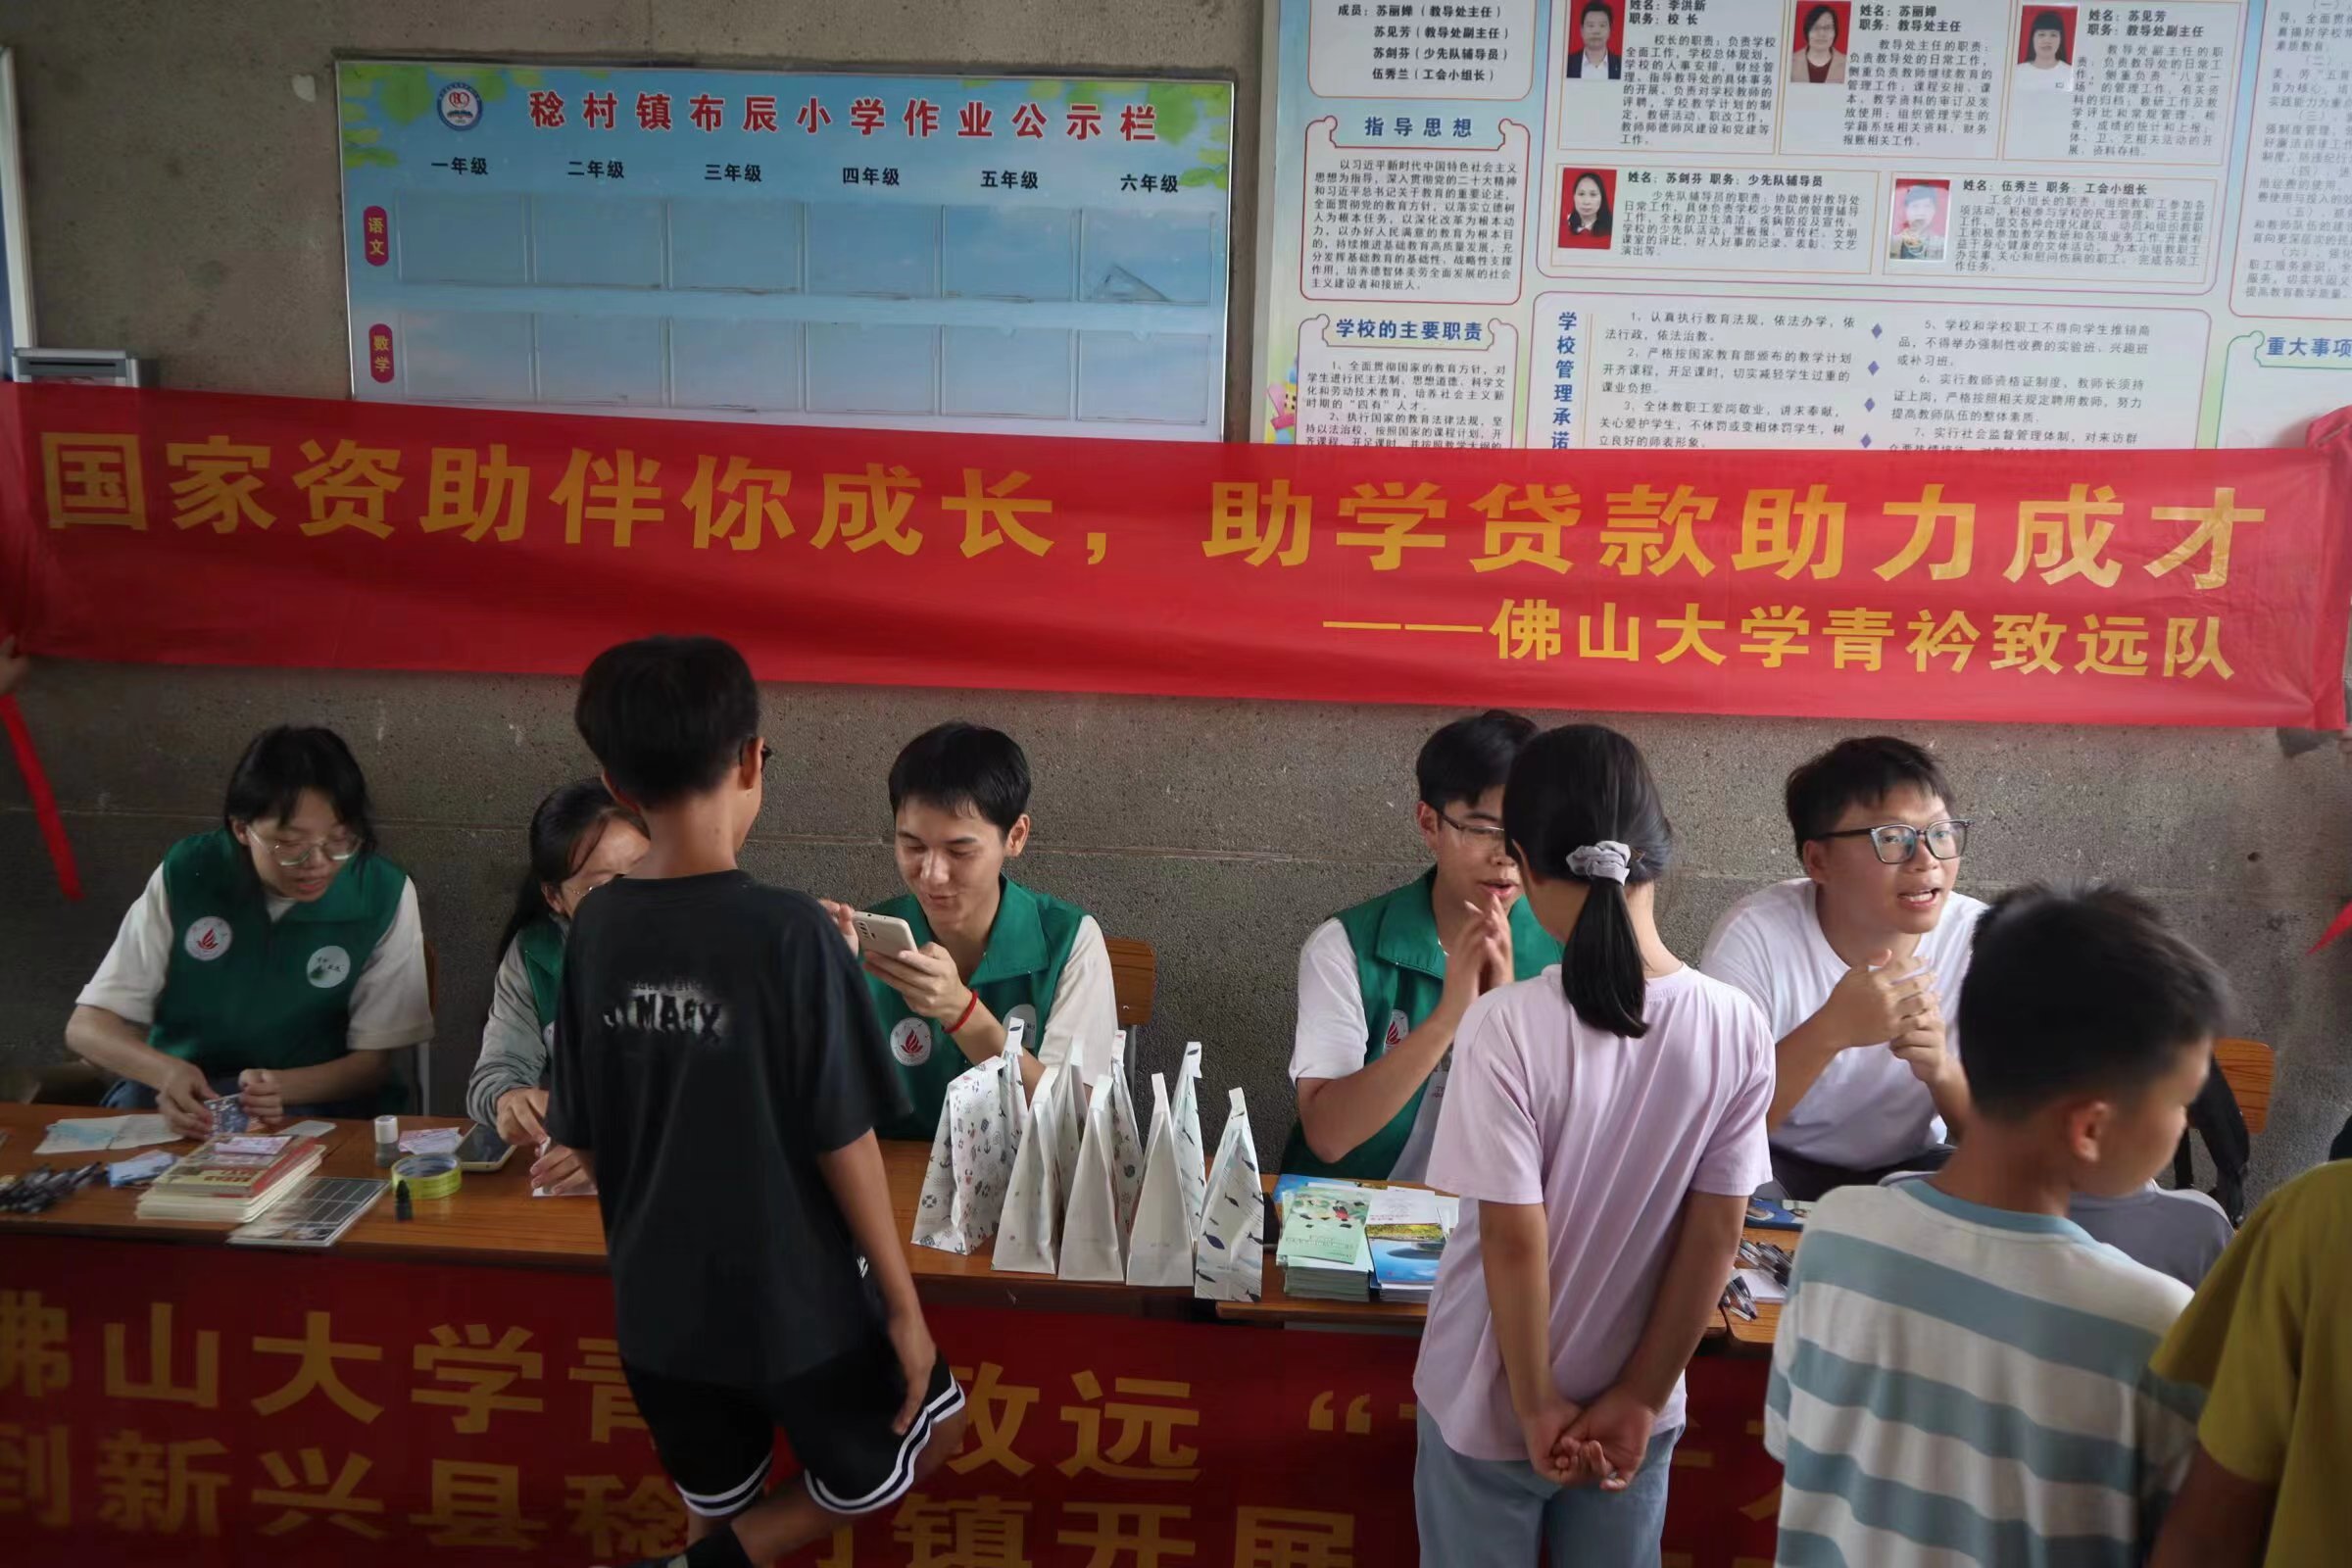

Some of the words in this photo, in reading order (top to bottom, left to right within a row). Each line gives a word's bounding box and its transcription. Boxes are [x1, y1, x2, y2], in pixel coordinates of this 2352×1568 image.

[1859, 20, 1961, 32] 职务：教导处主任
[528, 88, 1158, 143] 稔村镇布辰小学作业公示栏
[1365, 116, 1473, 138] 指导思想
[431, 153, 489, 177] 一年级
[567, 158, 625, 181] 二年级
[704, 162, 762, 184] 三年级
[842, 166, 901, 188] 四年级
[980, 169, 1039, 191] 五年级
[1119, 172, 1179, 195] 六年级
[1340, 159, 1518, 173] 以习近平新时代中国特色社会主义
[368, 216, 386, 257] 语文
[1336, 318, 1483, 341] 学校的主要职责
[2267, 336, 2352, 358] 重大事项
[372, 334, 391, 374] 数学
[1551, 311, 1578, 449] 学校管理承诺
[40, 431, 2265, 590] 国家资助伴你成长，助学贷款助力成才
